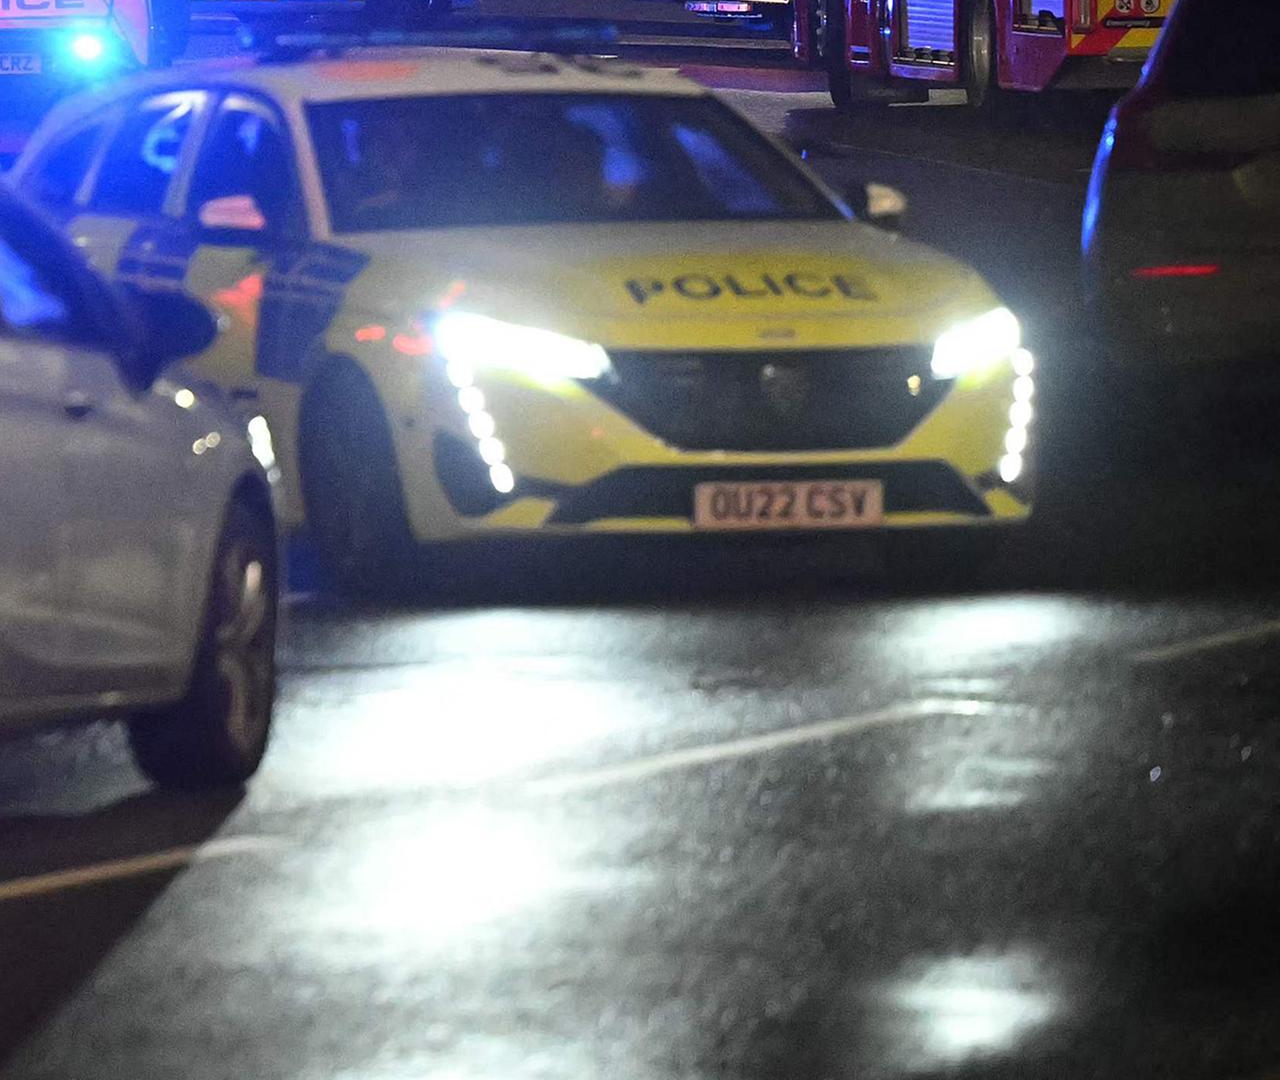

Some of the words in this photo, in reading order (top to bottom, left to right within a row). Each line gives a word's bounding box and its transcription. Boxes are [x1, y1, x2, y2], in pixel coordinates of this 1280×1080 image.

[0, 54, 34, 71] CRZ
[624, 273, 878, 305] POLICE
[709, 485, 794, 520] OU22
